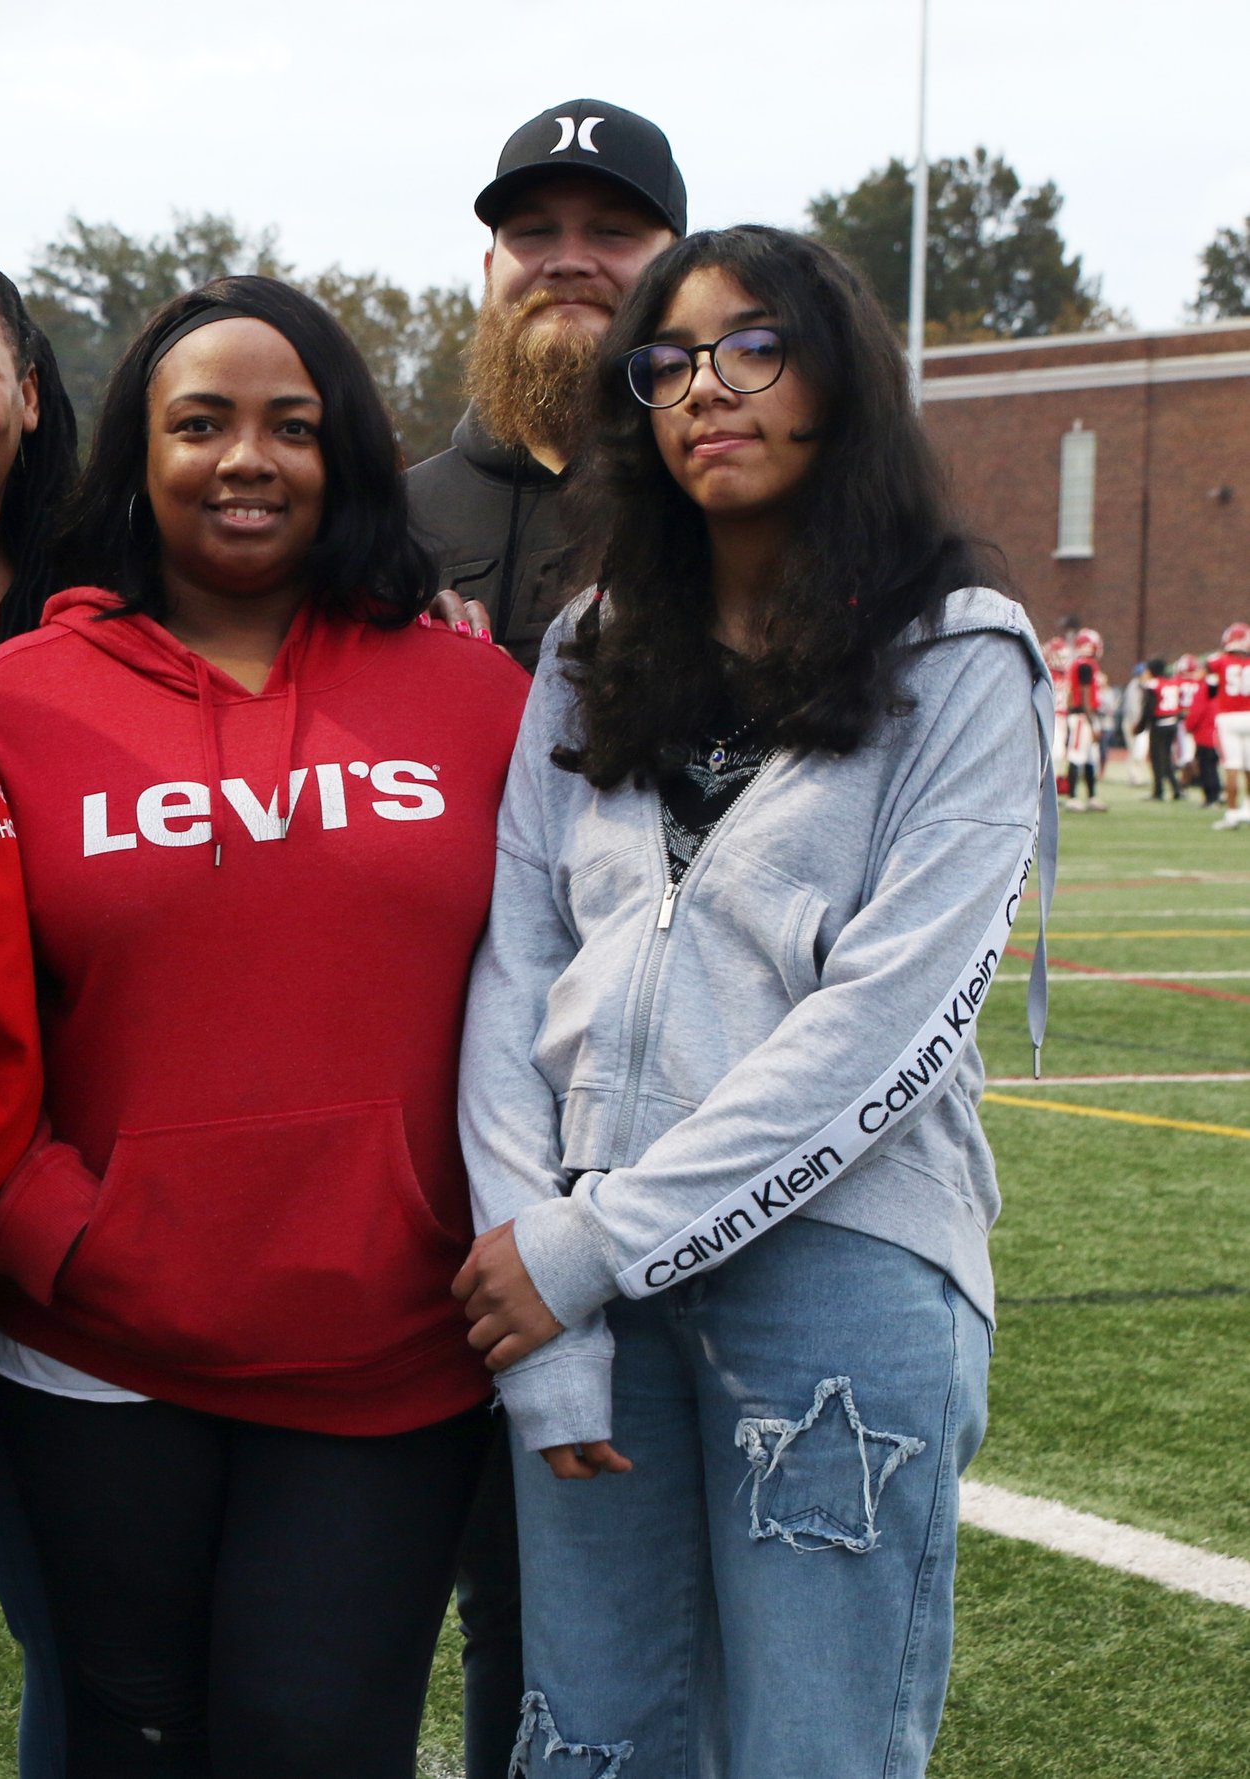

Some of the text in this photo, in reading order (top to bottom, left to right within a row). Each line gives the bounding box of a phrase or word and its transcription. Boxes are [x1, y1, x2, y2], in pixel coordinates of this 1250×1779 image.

[858, 948, 998, 1135] Calvin Klein
[644, 1144, 843, 1288] Calvin Klein
